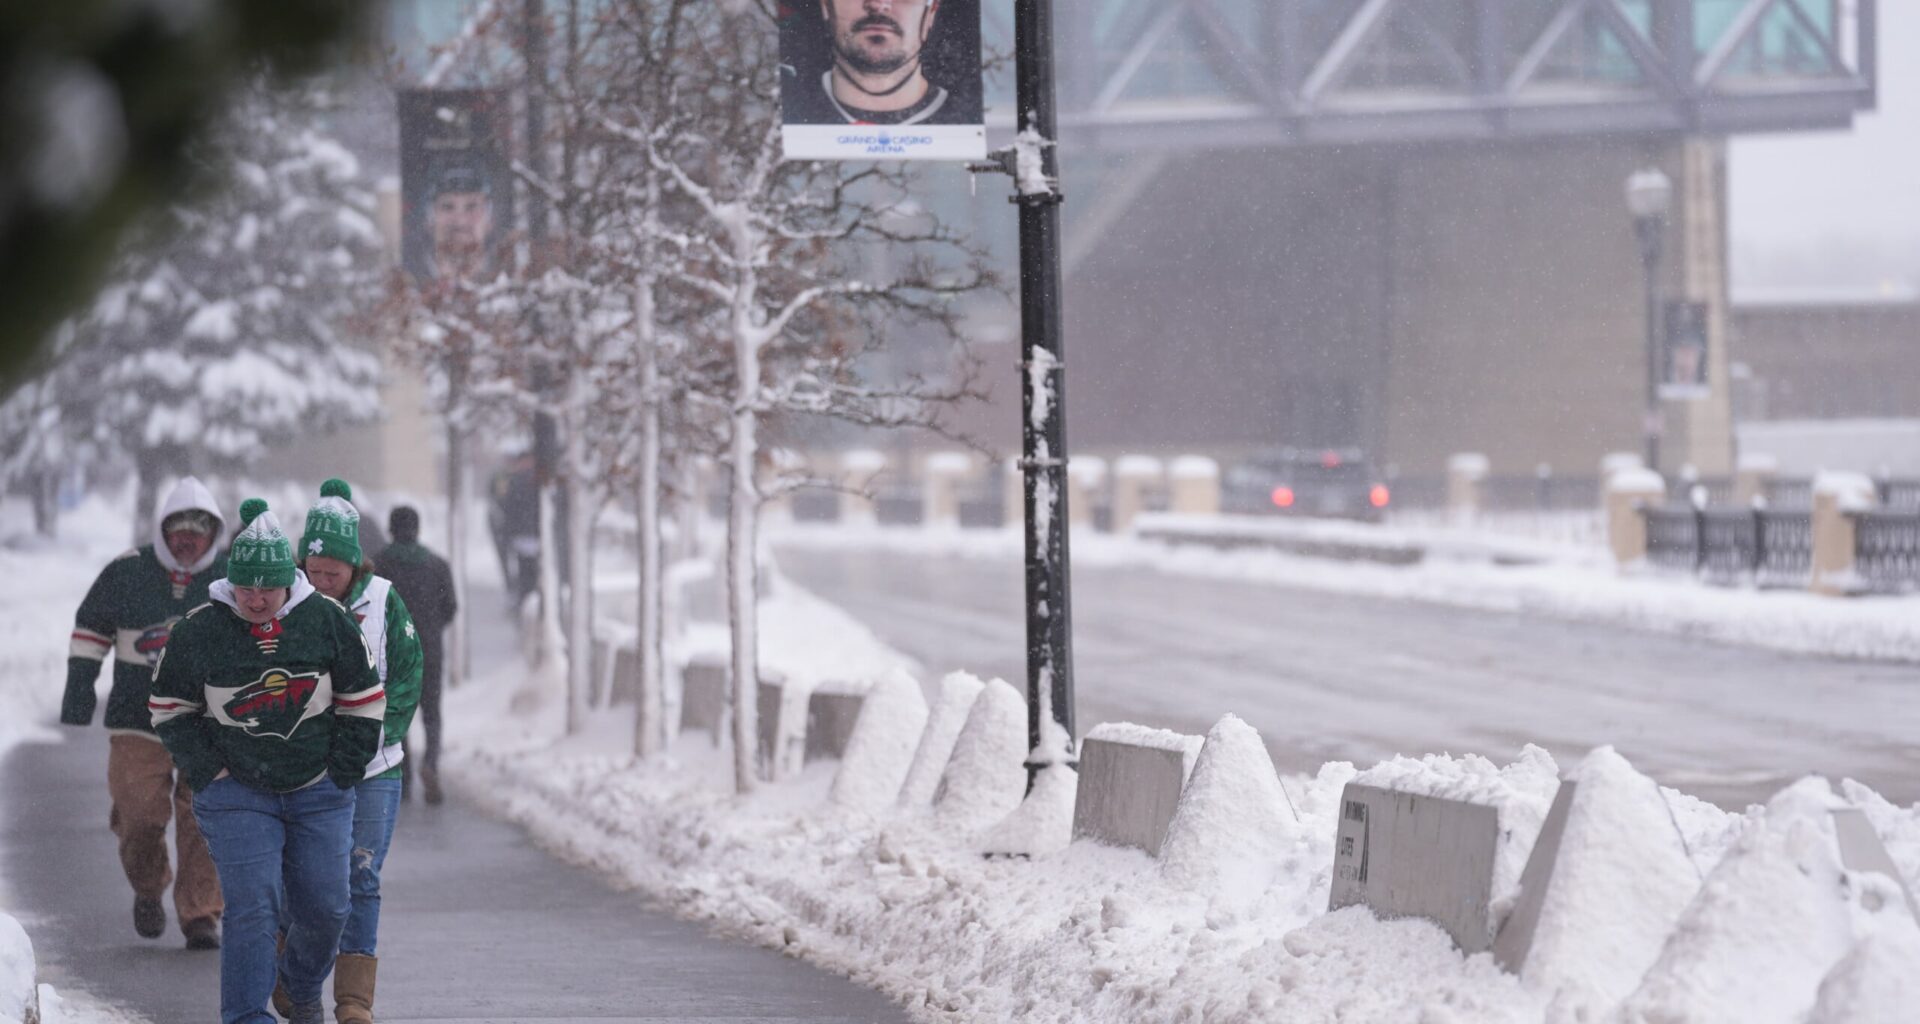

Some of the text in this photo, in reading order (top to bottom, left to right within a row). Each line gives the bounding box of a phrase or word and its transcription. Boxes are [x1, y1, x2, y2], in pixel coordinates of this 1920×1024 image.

[837, 135, 933, 145] GRAND CASINO
[866, 145, 905, 153] ARENA
